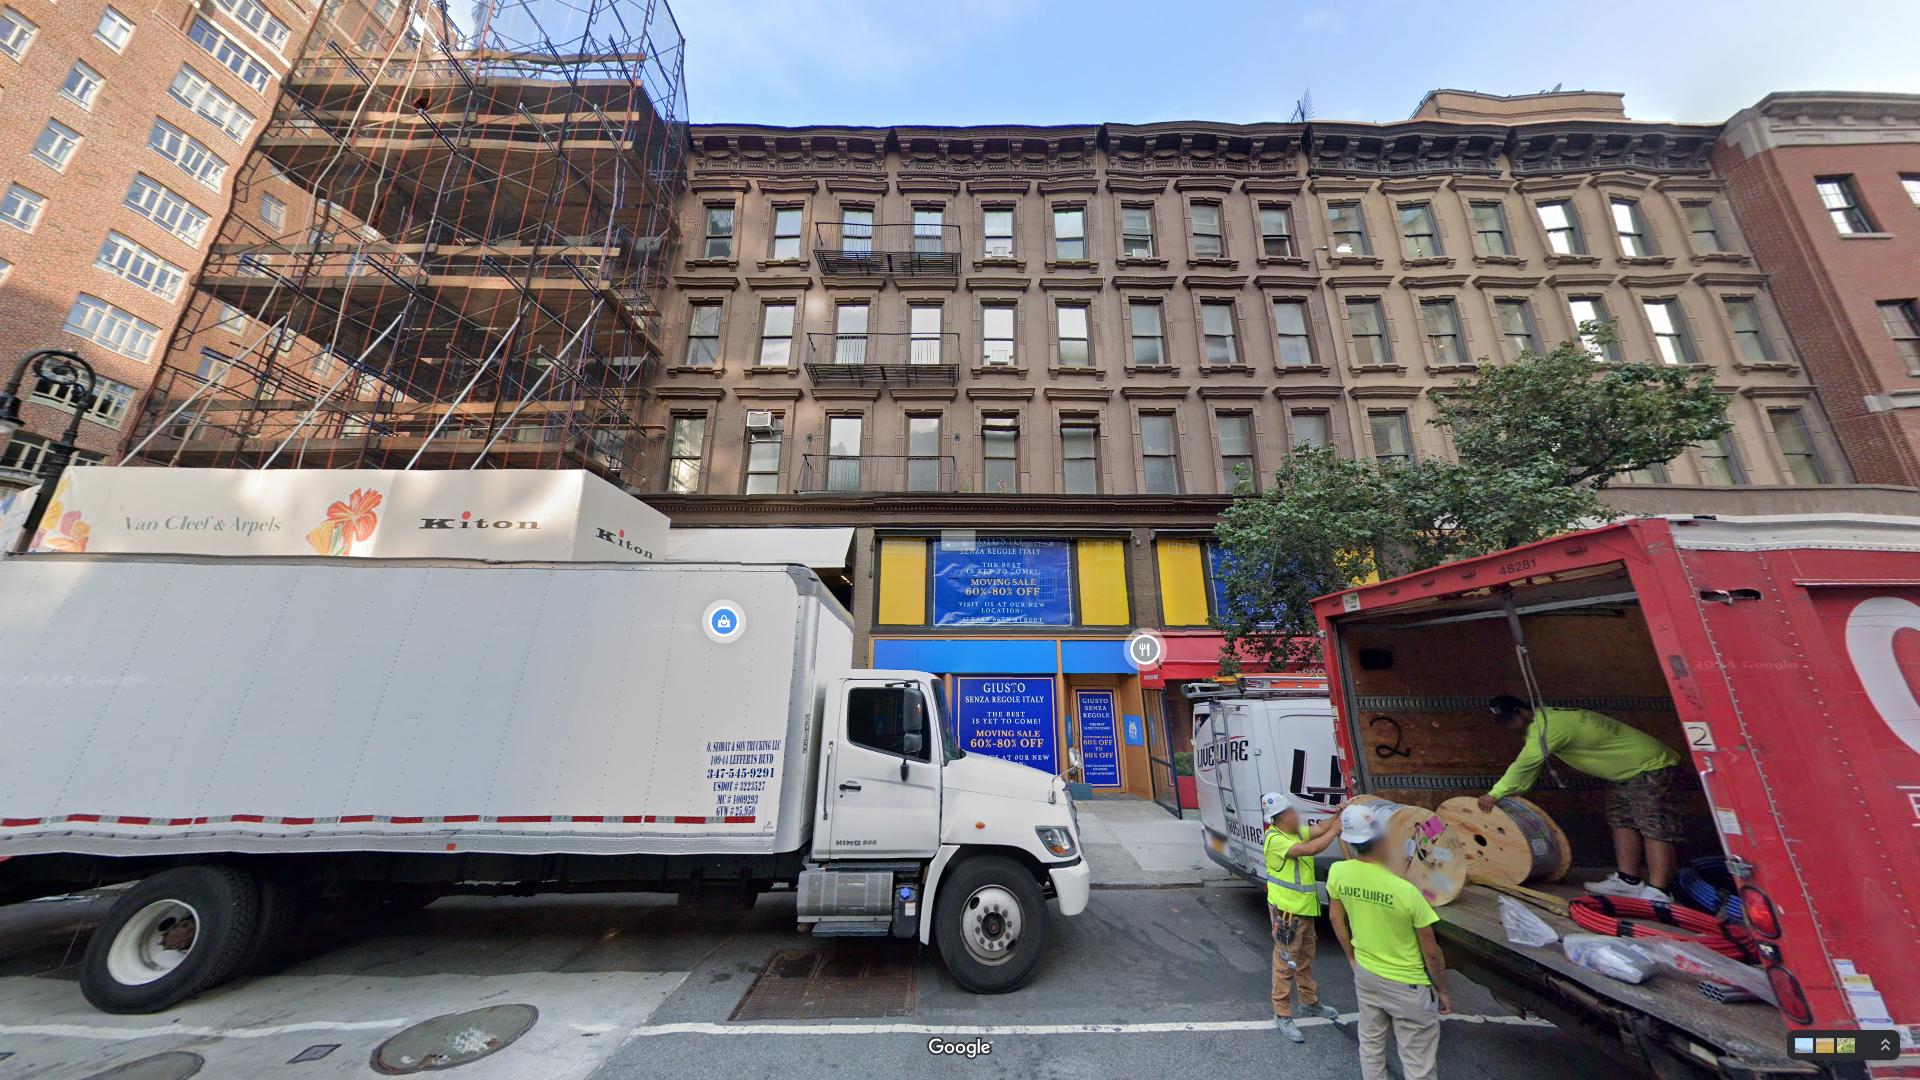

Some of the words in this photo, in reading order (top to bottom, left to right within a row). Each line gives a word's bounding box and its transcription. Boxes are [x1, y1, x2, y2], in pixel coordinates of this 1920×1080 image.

[124, 516, 159, 532] Van
[164, 515, 212, 531] Cleef
[214, 522, 225, 532] &
[231, 516, 282, 536] Arpels
[418, 511, 540, 530] Kiton
[595, 528, 653, 560] Kiton
[987, 547, 1017, 555] REGOLE
[1019, 547, 1041, 555] ITALY
[1498, 559, 1536, 577] 48281
[970, 578, 1010, 586] MOVING
[1012, 578, 1037, 586] SALE
[965, 587, 1013, 596] 60%-80%
[1016, 587, 1040, 596] OFF
[983, 682, 1026, 693] GIUSTO
[965, 695, 990, 703] SENZA
[991, 695, 1021, 703] REGOLE
[1022, 695, 1045, 703] ITALY
[972, 717, 980, 725] IS
[982, 717, 997, 725] YET
[1000, 717, 1012, 725] TO
[1014, 717, 1041, 725] COME!
[975, 729, 1015, 737] MOVING
[1016, 729, 1041, 737] SALE
[1369, 715, 1411, 759] 2
[1687, 726, 1712, 747] 2
[772, 739, 782, 750] LLC
[970, 738, 1017, 748] 60%-80%
[1019, 738, 1044, 748] OFF
[730, 754, 757, 764] LEFFERTS
[758, 753, 774, 764] BLVD
[707, 768, 774, 778] 347-545-9291
[713, 781, 733, 791] USDOT
[1338, 884, 1361, 898] LIVE
[1362, 888, 1394, 906] WIRE
